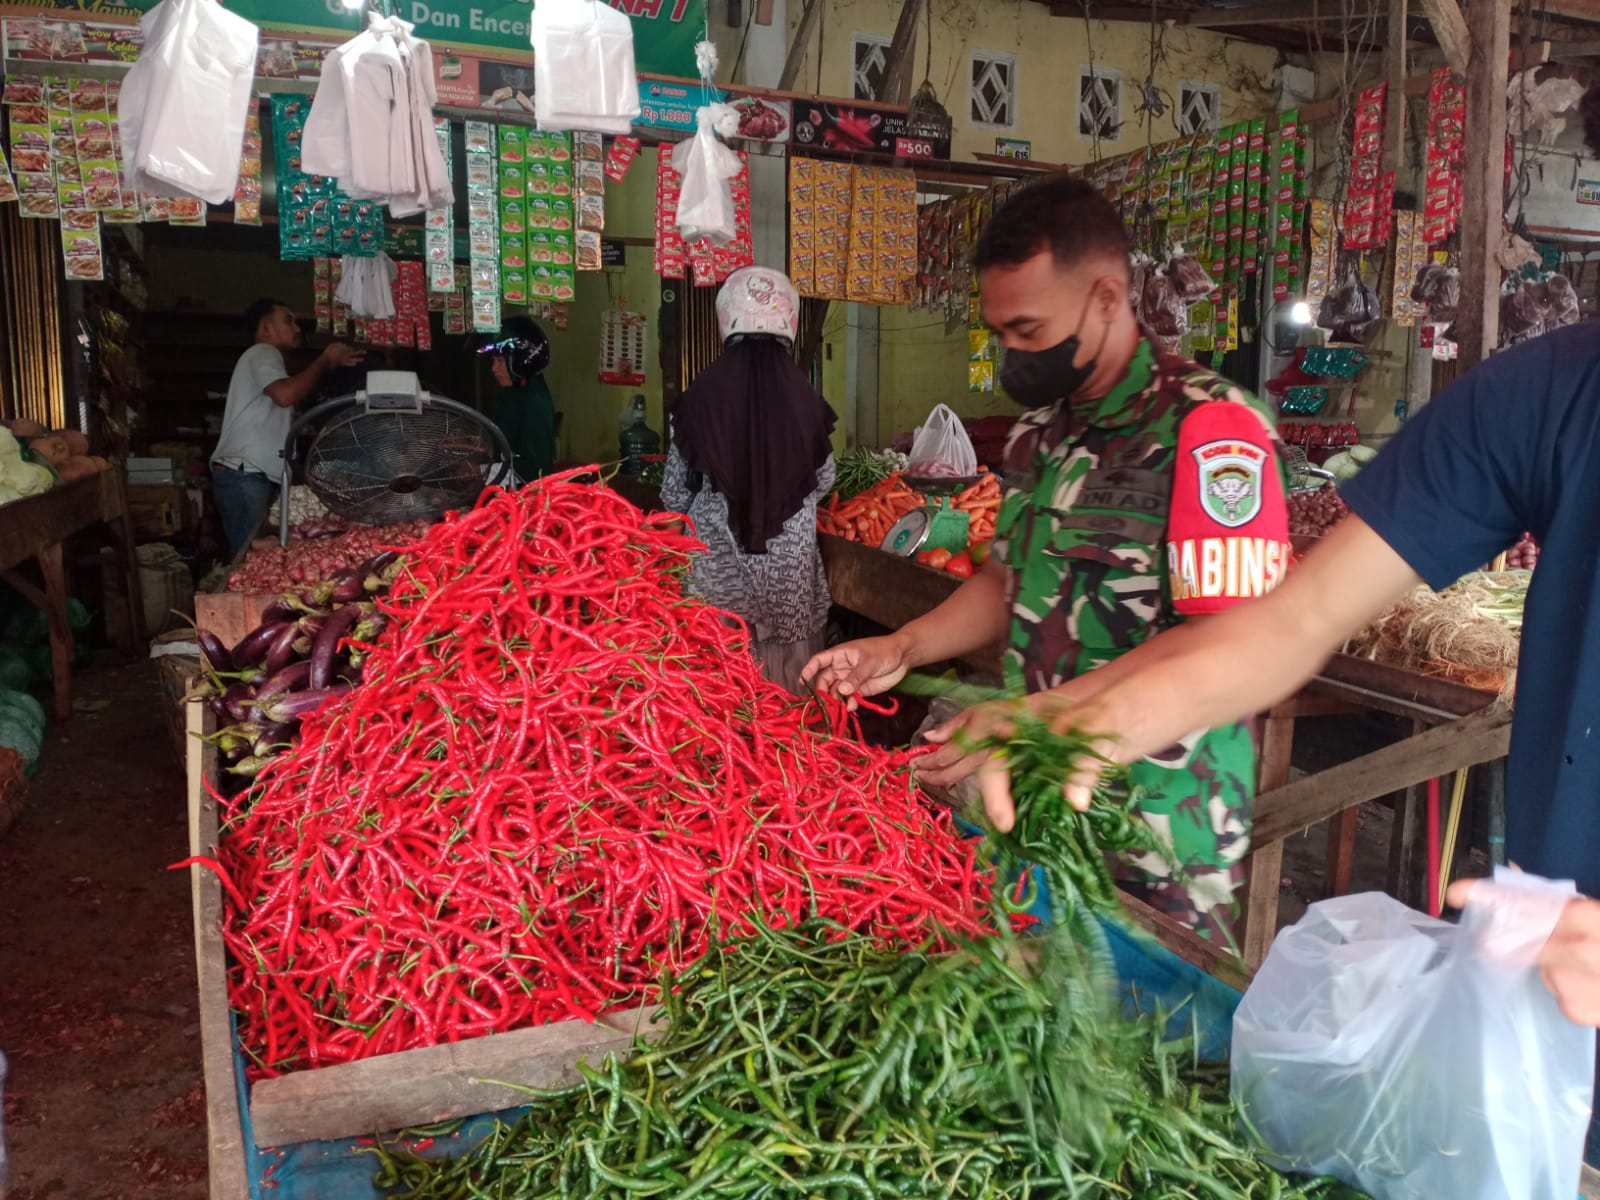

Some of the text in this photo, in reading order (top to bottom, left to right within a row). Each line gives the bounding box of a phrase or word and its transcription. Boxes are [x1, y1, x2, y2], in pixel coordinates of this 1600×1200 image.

[412, 2, 460, 28] Dan
[643, 106, 692, 124] Rp 1.000
[885, 118, 904, 127] UNIK
